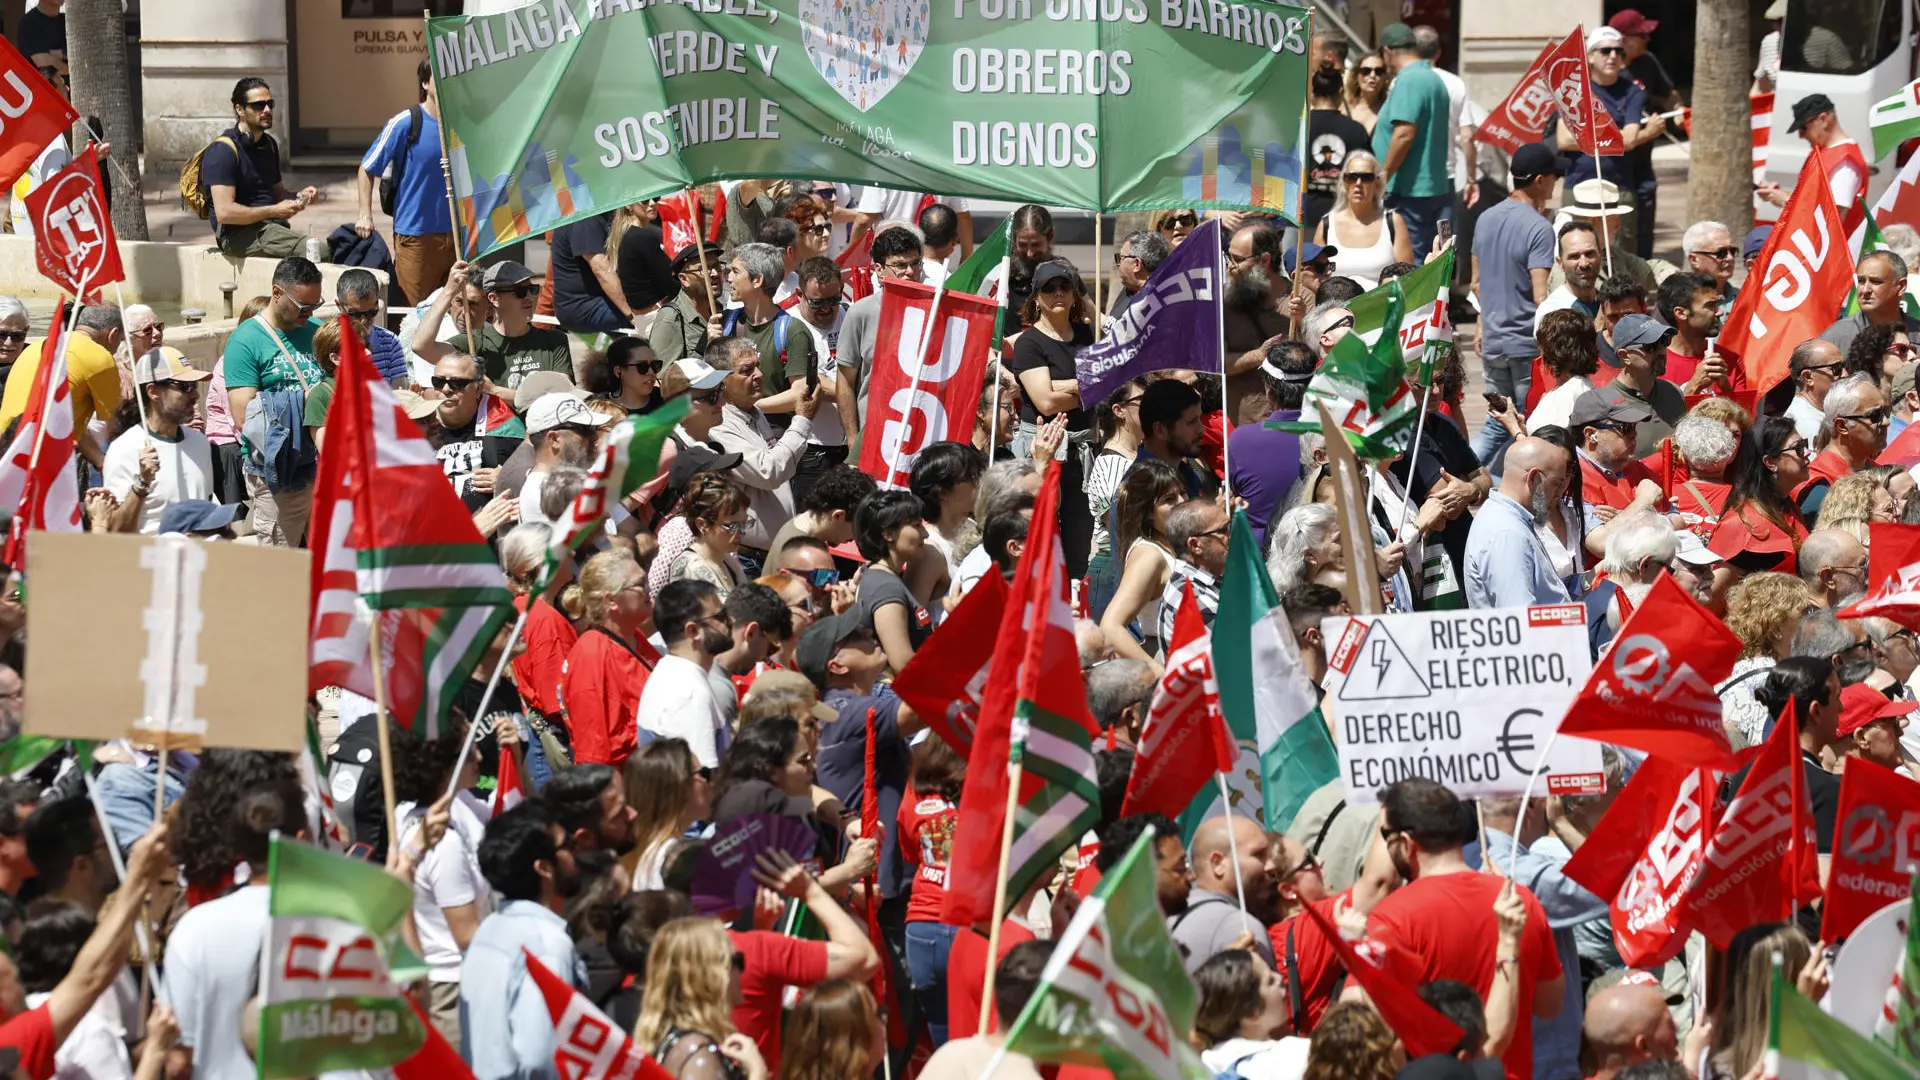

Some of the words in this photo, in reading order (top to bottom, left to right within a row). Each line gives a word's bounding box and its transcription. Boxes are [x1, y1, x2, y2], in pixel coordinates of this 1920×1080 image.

[354, 30, 408, 43] PULSA
[412, 30, 424, 42] Y
[354, 44, 394, 54] CREMA
[397, 44, 429, 54] SUAV
[755, 44, 778, 77] Y
[952, 48, 1133, 95] OBREROS
[952, 120, 1099, 168] DIGNOS
[1530, 608, 1571, 621] CCOO
[1430, 615, 1521, 650] RIESGO
[1428, 649, 1573, 690] ELÉCTRICO,
[1345, 710, 1462, 745] DERECHO
[1350, 746, 1500, 789] ECONÓMICO
[1550, 775, 1590, 788] CCOO
